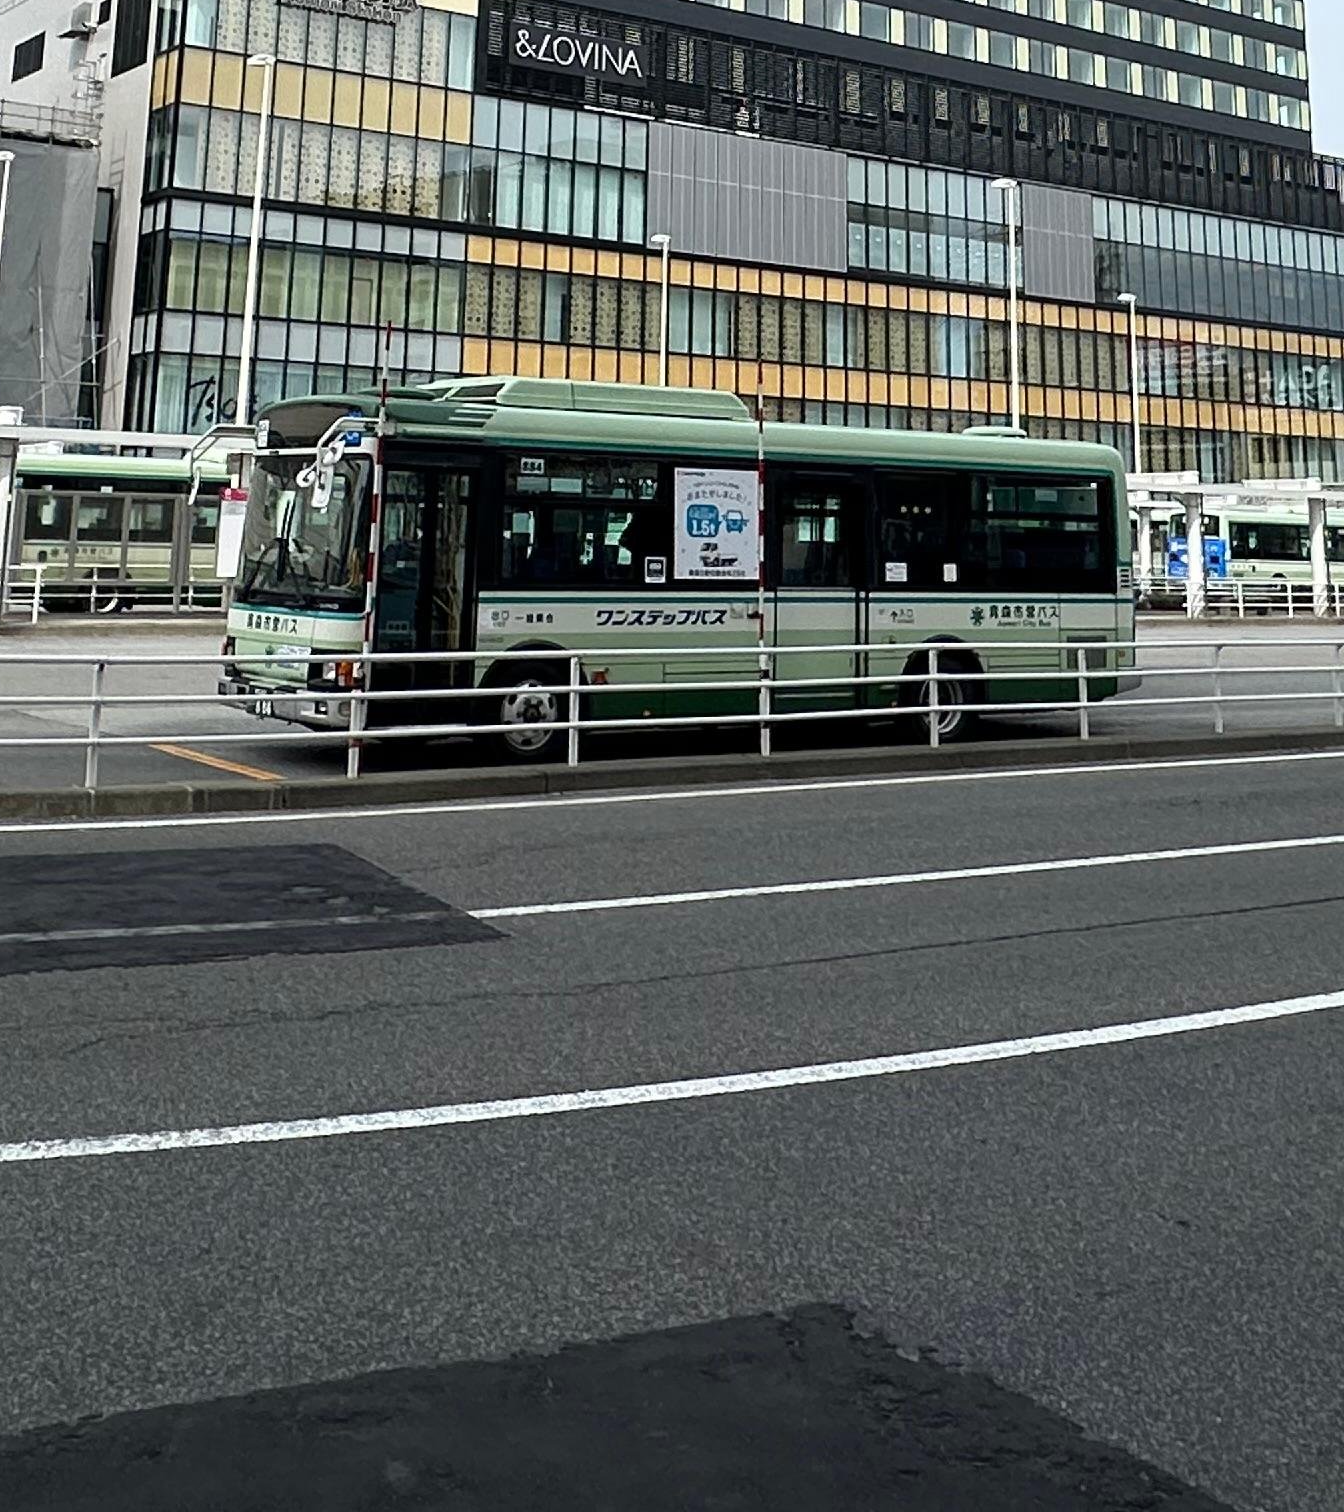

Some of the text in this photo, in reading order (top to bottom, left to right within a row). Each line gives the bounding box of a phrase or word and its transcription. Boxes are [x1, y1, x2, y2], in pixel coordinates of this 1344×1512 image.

[346, 0, 401, 24] Station
[596, 610, 728, 626] ワンステップバス
[989, 604, 1060, 619] 青森市営バス
[246, 613, 298, 635] 青森市営バス
